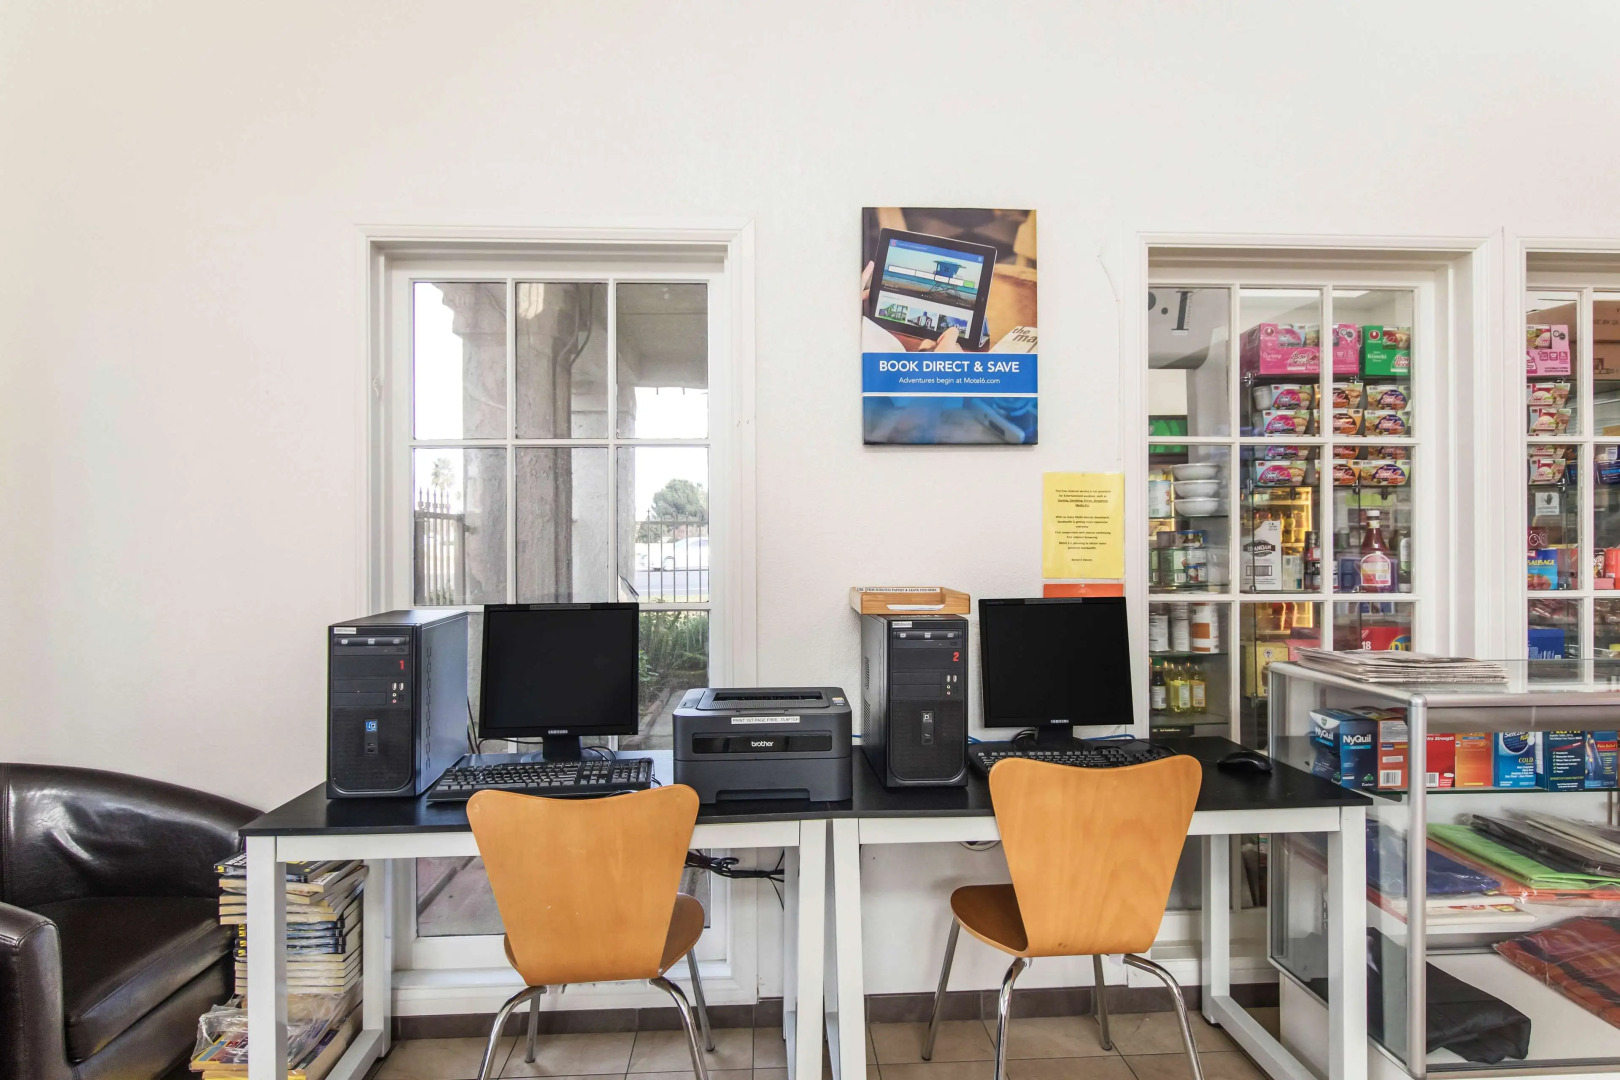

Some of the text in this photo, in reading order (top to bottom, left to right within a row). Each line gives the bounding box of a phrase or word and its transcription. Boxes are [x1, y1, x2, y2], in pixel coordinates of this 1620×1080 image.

[879, 360, 1020, 373] BOOK DIRECT & SAVE
[936, 377, 954, 386] begin
[1361, 640, 1372, 650] 18
[952, 651, 960, 662] 2
[399, 659, 405, 671] 1
[1315, 726, 1334, 741] NyQuil
[1342, 734, 1372, 746] NyQuil
